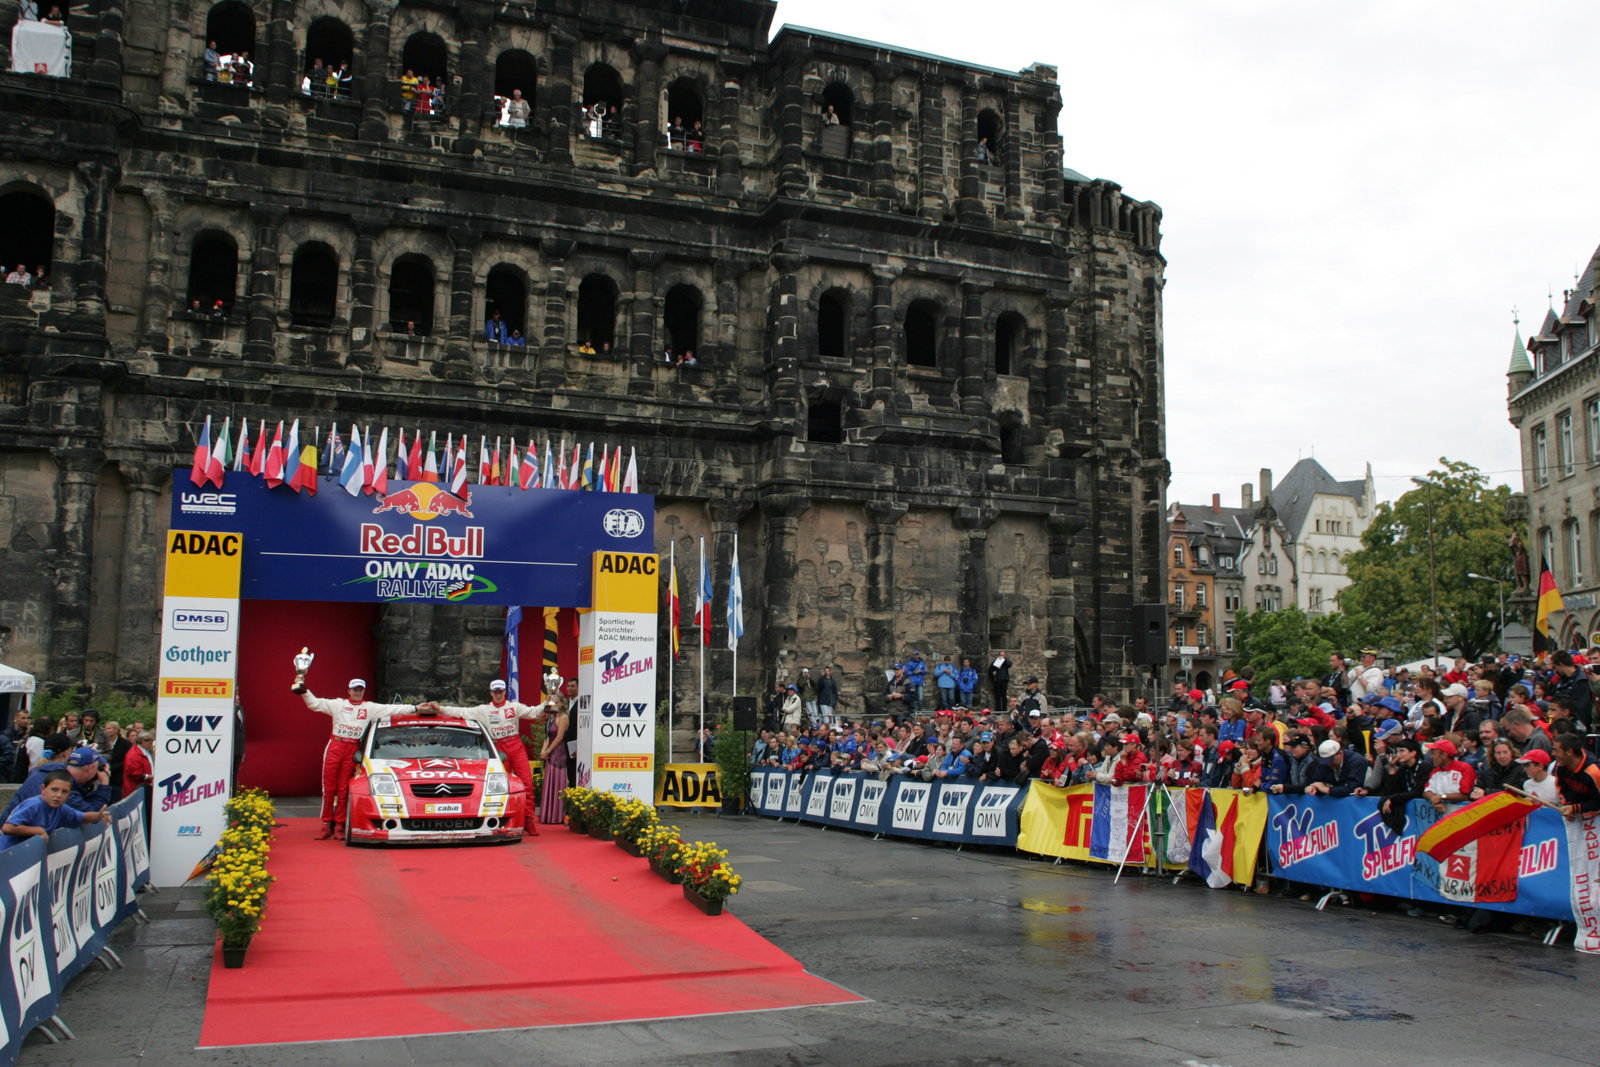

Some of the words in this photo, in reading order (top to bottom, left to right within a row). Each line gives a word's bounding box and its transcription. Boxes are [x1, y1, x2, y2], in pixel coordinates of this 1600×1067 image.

[181, 492, 237, 505] WRC
[170, 533, 239, 556] ADAC
[360, 523, 424, 555] Red
[425, 526, 485, 558] Bull
[365, 560, 420, 578] OMV
[425, 562, 475, 581] ADAC
[600, 554, 656, 575] ADAC
[377, 579, 447, 598] RALLYE
[176, 614, 225, 623] DMSB
[598, 618, 636, 627] Sportlicher
[598, 626, 636, 634] Ausrichter:
[165, 645, 232, 665] Gothaer
[598, 650, 630, 675] TV
[601, 656, 654, 685] SPIELFILM
[165, 680, 227, 695] PIRELLI
[601, 702, 648, 717] OMV
[166, 714, 223, 732] OMV
[601, 723, 647, 738] OMV
[165, 738, 221, 754] OMV
[598, 756, 649, 768] PIRELLI
[406, 770, 477, 779] TOTAL
[158, 772, 197, 800] TV
[161, 779, 225, 812] SPIELFILM
[832, 800, 850, 813] OMV
[859, 804, 876, 818] OMV
[896, 807, 921, 822] OMV
[937, 811, 963, 826] OMV
[976, 812, 1001, 828] OMV
[1272, 803, 1314, 845] TV
[1279, 820, 1339, 869] SPIELFILM
[1576, 872, 1600, 952] CASTILLO
